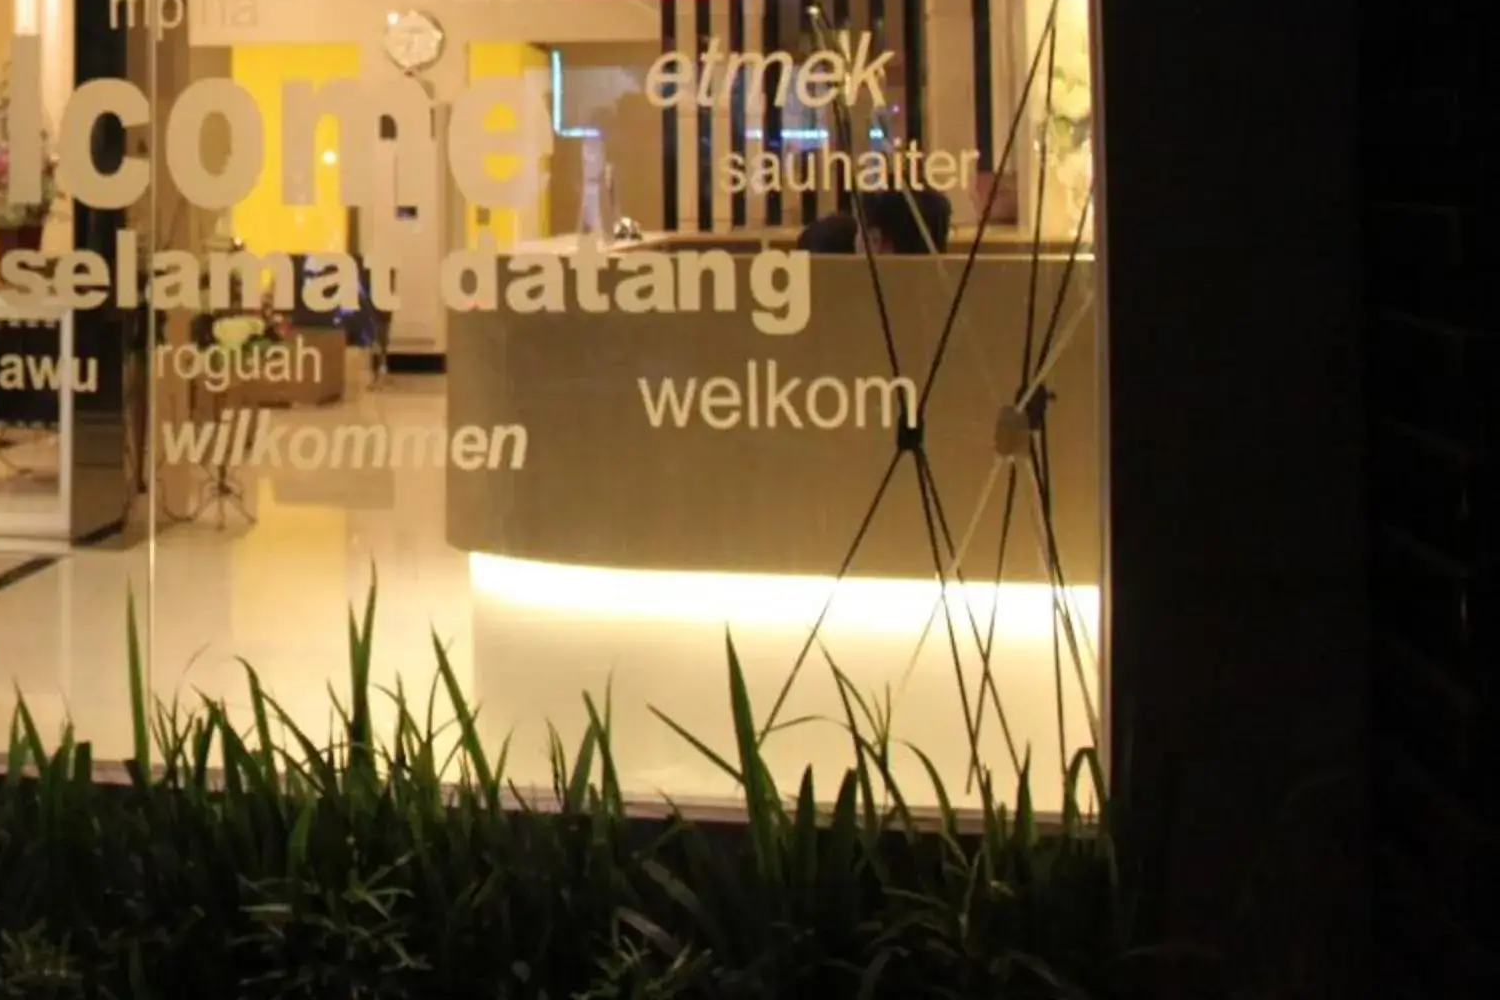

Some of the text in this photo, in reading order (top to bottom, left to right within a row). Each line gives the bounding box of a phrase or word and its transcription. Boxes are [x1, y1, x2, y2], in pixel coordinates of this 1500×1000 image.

[644, 28, 896, 109] etmek
[717, 145, 980, 194] sauhaiter
[0, 222, 811, 336] selamat datang
[154, 338, 324, 393] roguah
[637, 360, 920, 430] welkom
[161, 408, 530, 472] wilkommen
